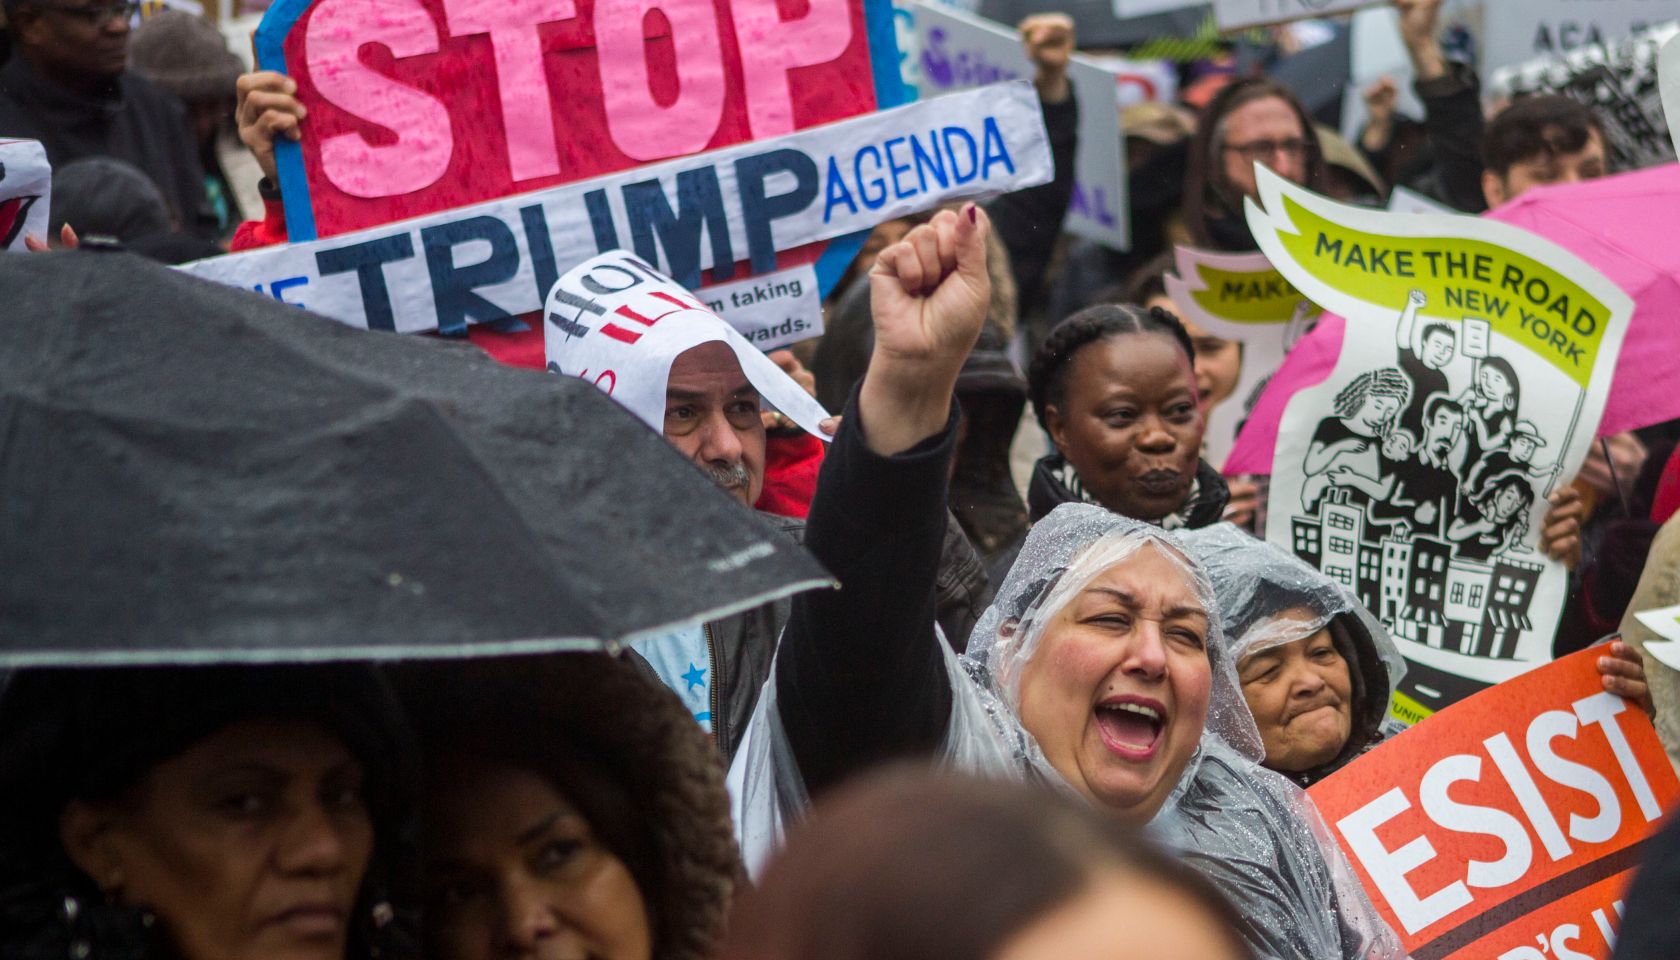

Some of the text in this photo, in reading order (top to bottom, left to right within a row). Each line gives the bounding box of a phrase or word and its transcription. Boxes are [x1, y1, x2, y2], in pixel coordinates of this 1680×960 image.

[306, 0, 853, 198] STOP
[316, 116, 1016, 337] TRUMP AGENDA
[730, 279, 803, 308] taking
[743, 318, 811, 343] wards.
[1314, 232, 1596, 337] MAKE THE ROAD
[1445, 287, 1586, 366] NEW YORK
[1336, 691, 1663, 936] ESIST
